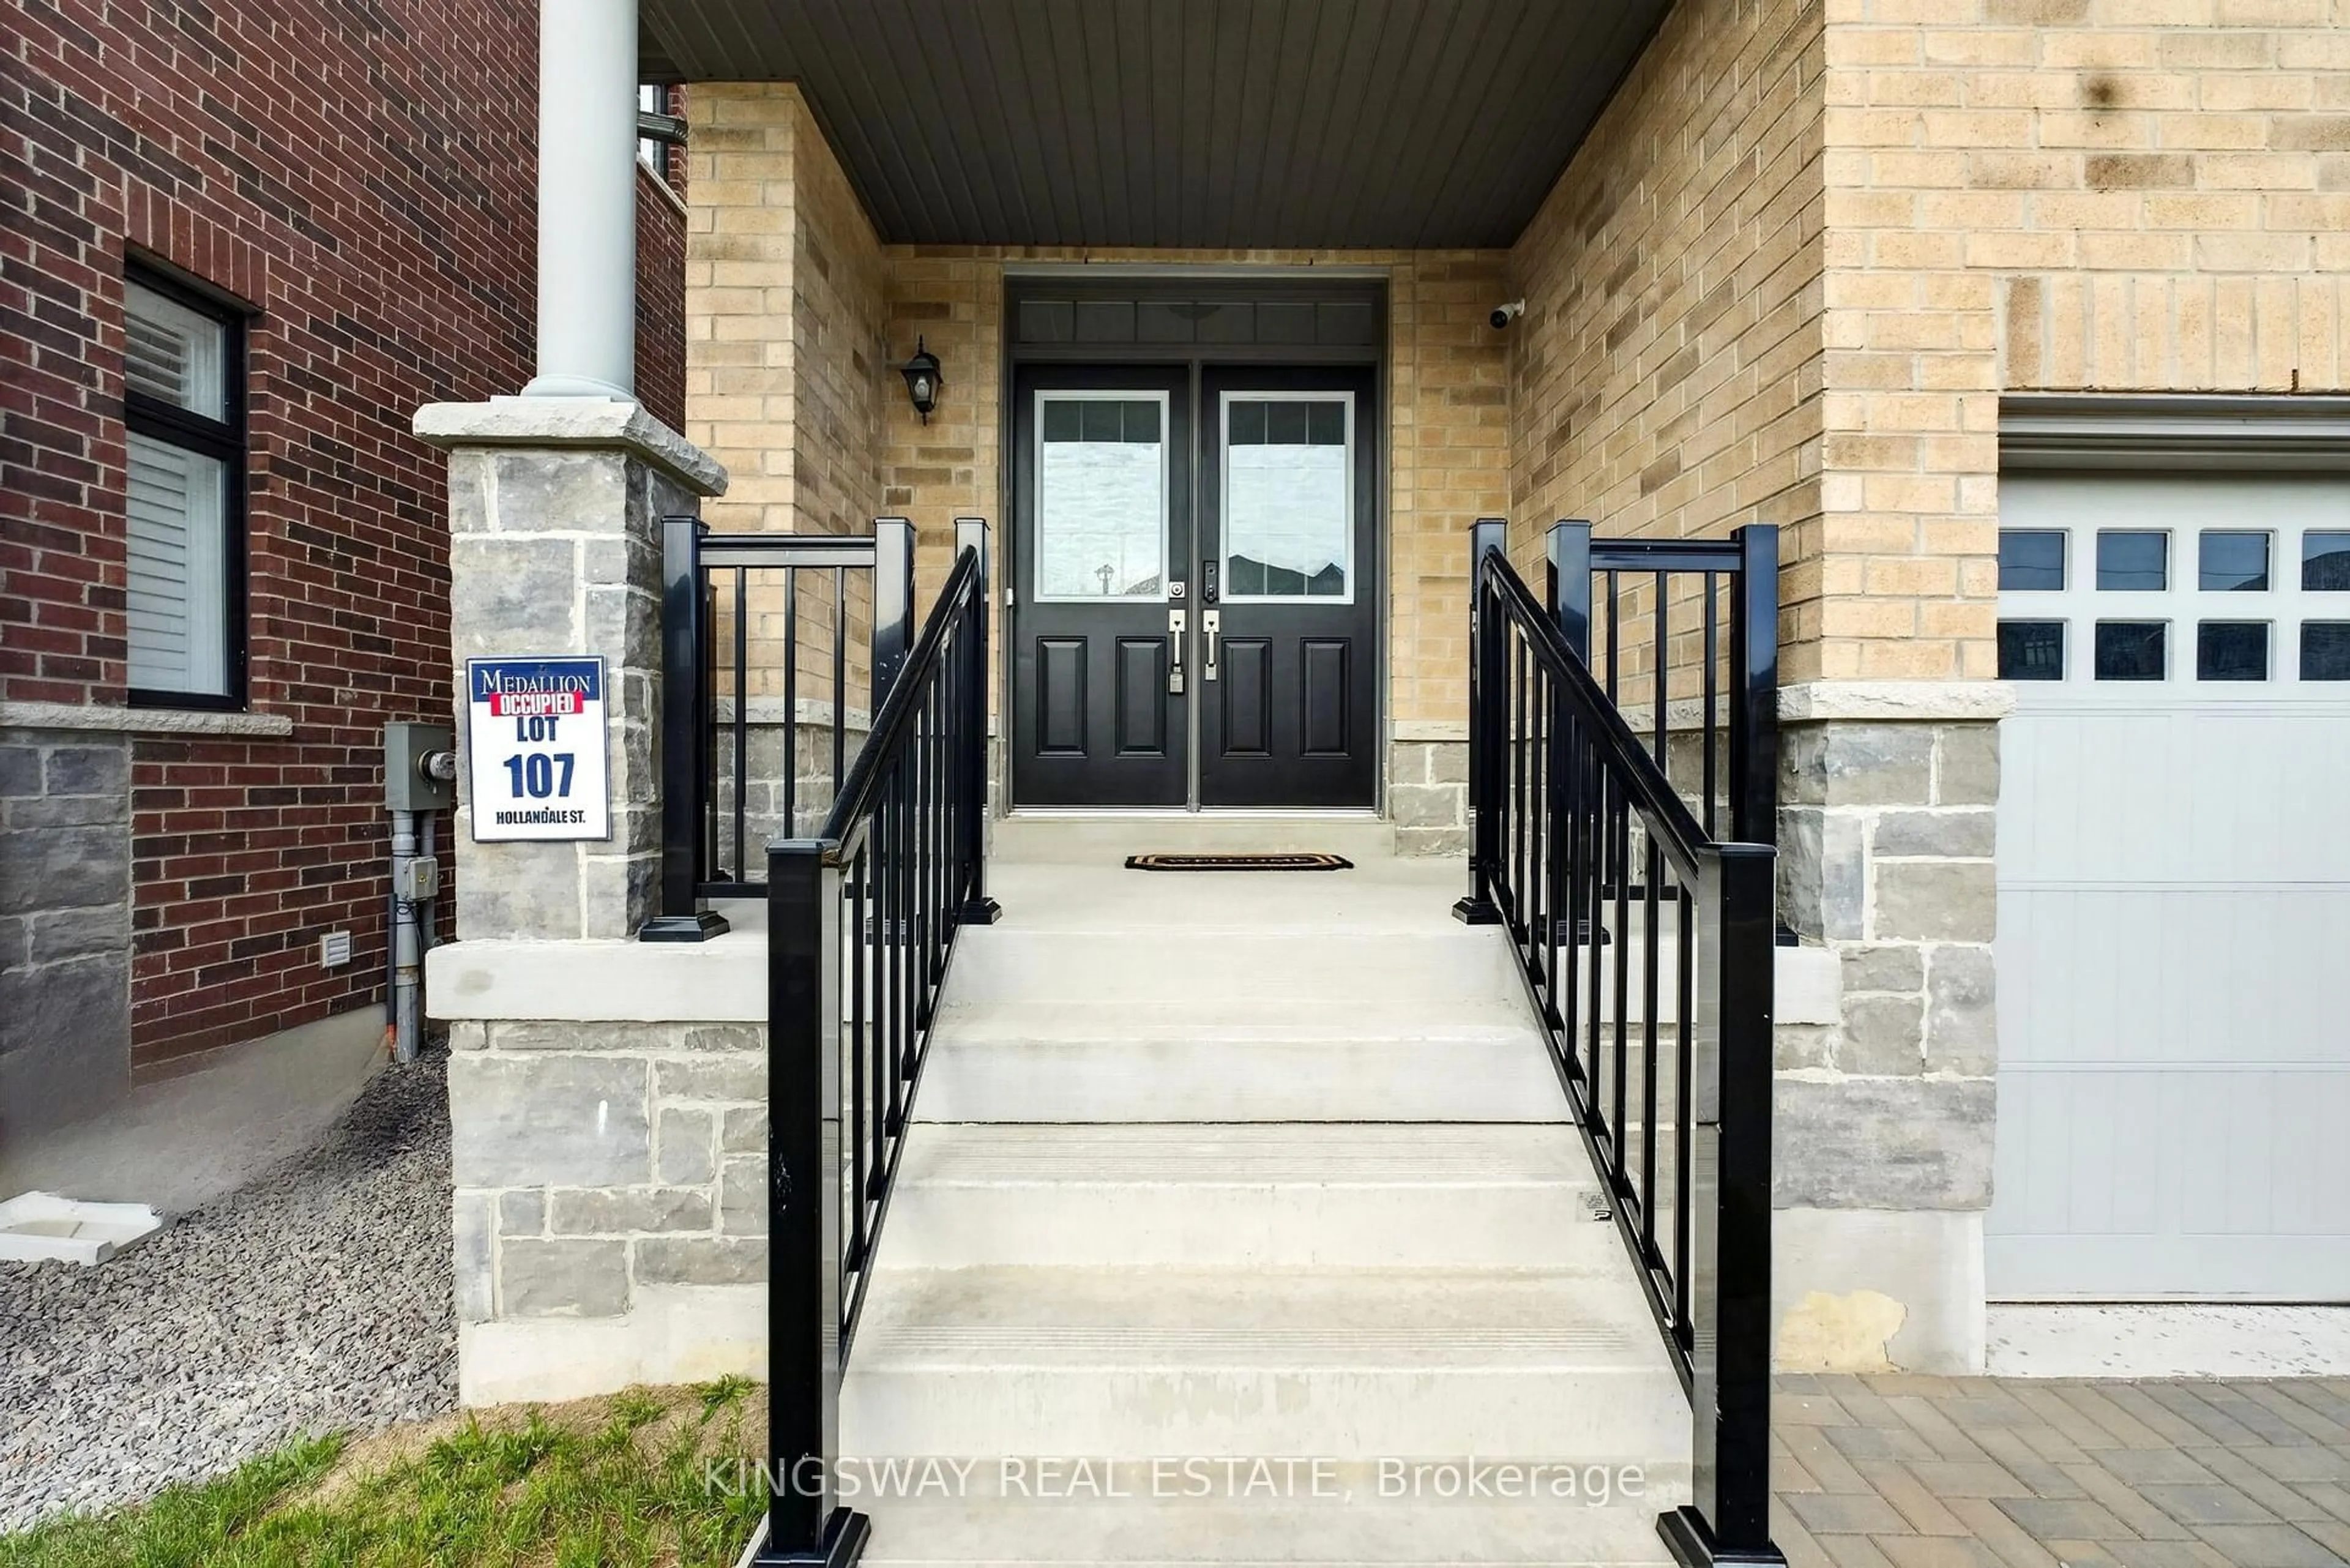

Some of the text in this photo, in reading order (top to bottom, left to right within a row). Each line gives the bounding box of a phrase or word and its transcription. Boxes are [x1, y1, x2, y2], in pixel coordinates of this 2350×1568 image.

[480, 670, 591, 695] MEDALLION
[501, 693, 574, 715] OCCUPIED
[517, 716, 559, 742] LOT
[503, 753, 575, 798] 107
[496, 810, 586, 824] HOLLANDALE ST.
